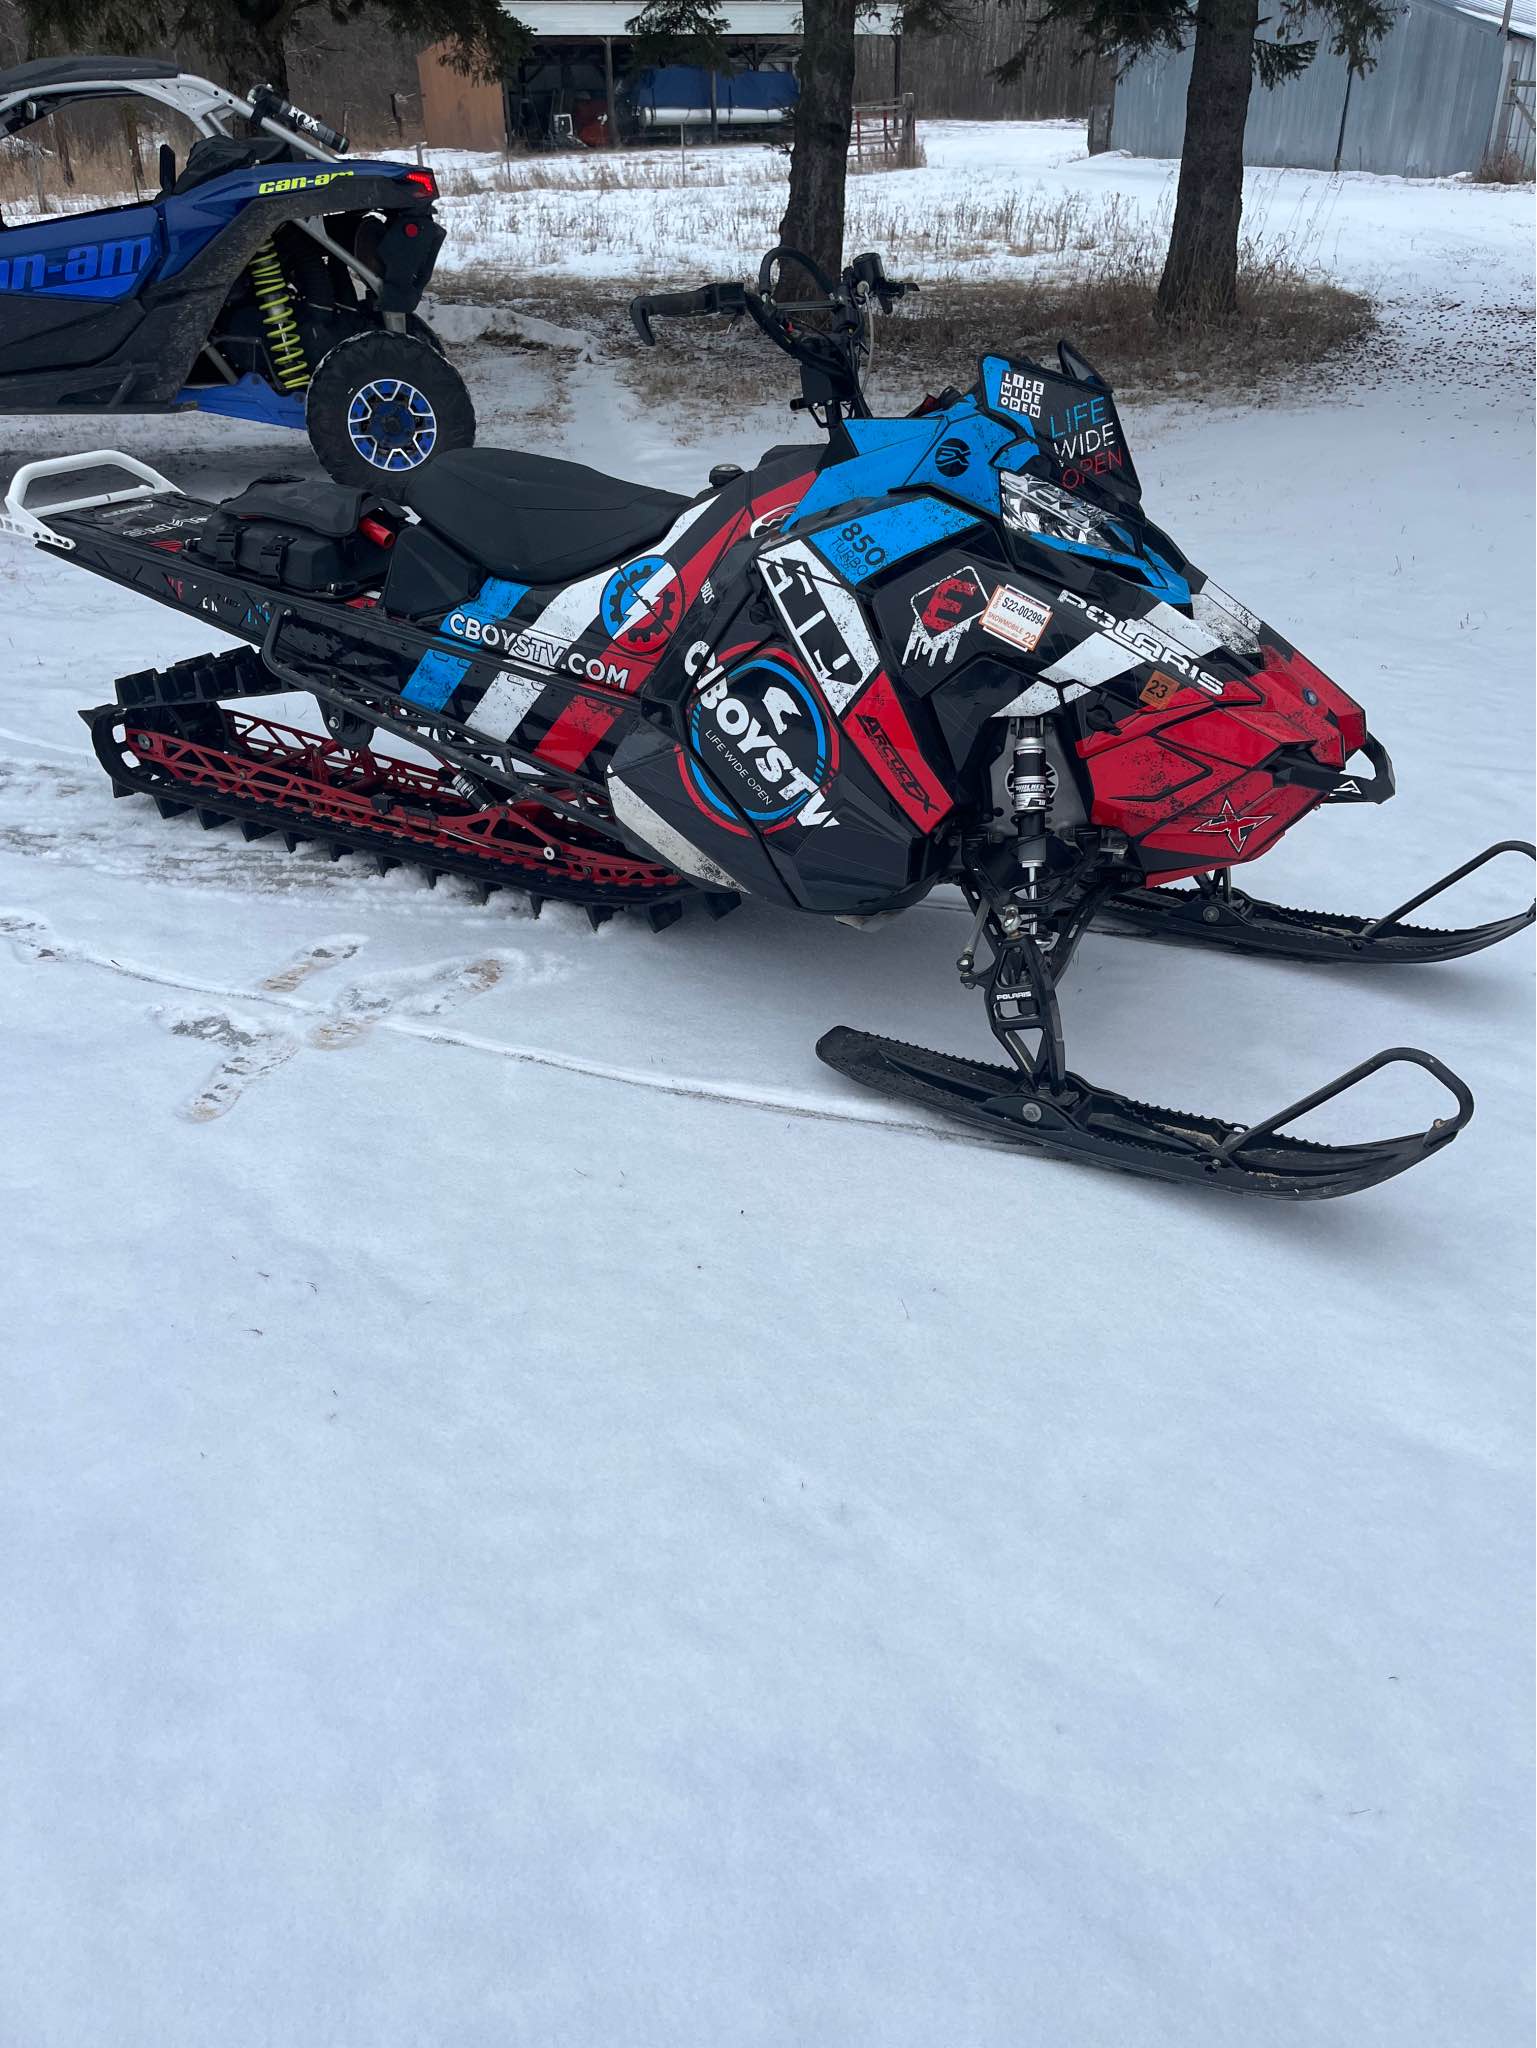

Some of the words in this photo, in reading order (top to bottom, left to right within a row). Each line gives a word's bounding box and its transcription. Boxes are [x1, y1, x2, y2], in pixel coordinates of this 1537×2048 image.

[288, 105, 320, 133] FOX
[1000, 381, 1041, 404] WIDE
[1003, 372, 1045, 396] LIFE
[1000, 396, 1041, 419] OPEN
[1050, 396, 1105, 439] LIFE
[1053, 422, 1116, 467] WIDE
[1061, 449, 1122, 490] OPEN
[831, 535, 869, 577] TURBO
[841, 522, 886, 566] 850
[1002, 596, 1046, 627] S22-002994
[449, 613, 630, 690] CBOYSTV.COM
[1023, 631, 1037, 646] 22
[1056, 589, 1225, 696] POLARIS
[1145, 679, 1169, 699] 23
[683, 640, 841, 829] CBOYSTV
[705, 729, 727, 752] LIFE
[724, 750, 750, 778] WIDE
[747, 777, 773, 806] OPEN
[996, 990, 1032, 1001] POLARIS
